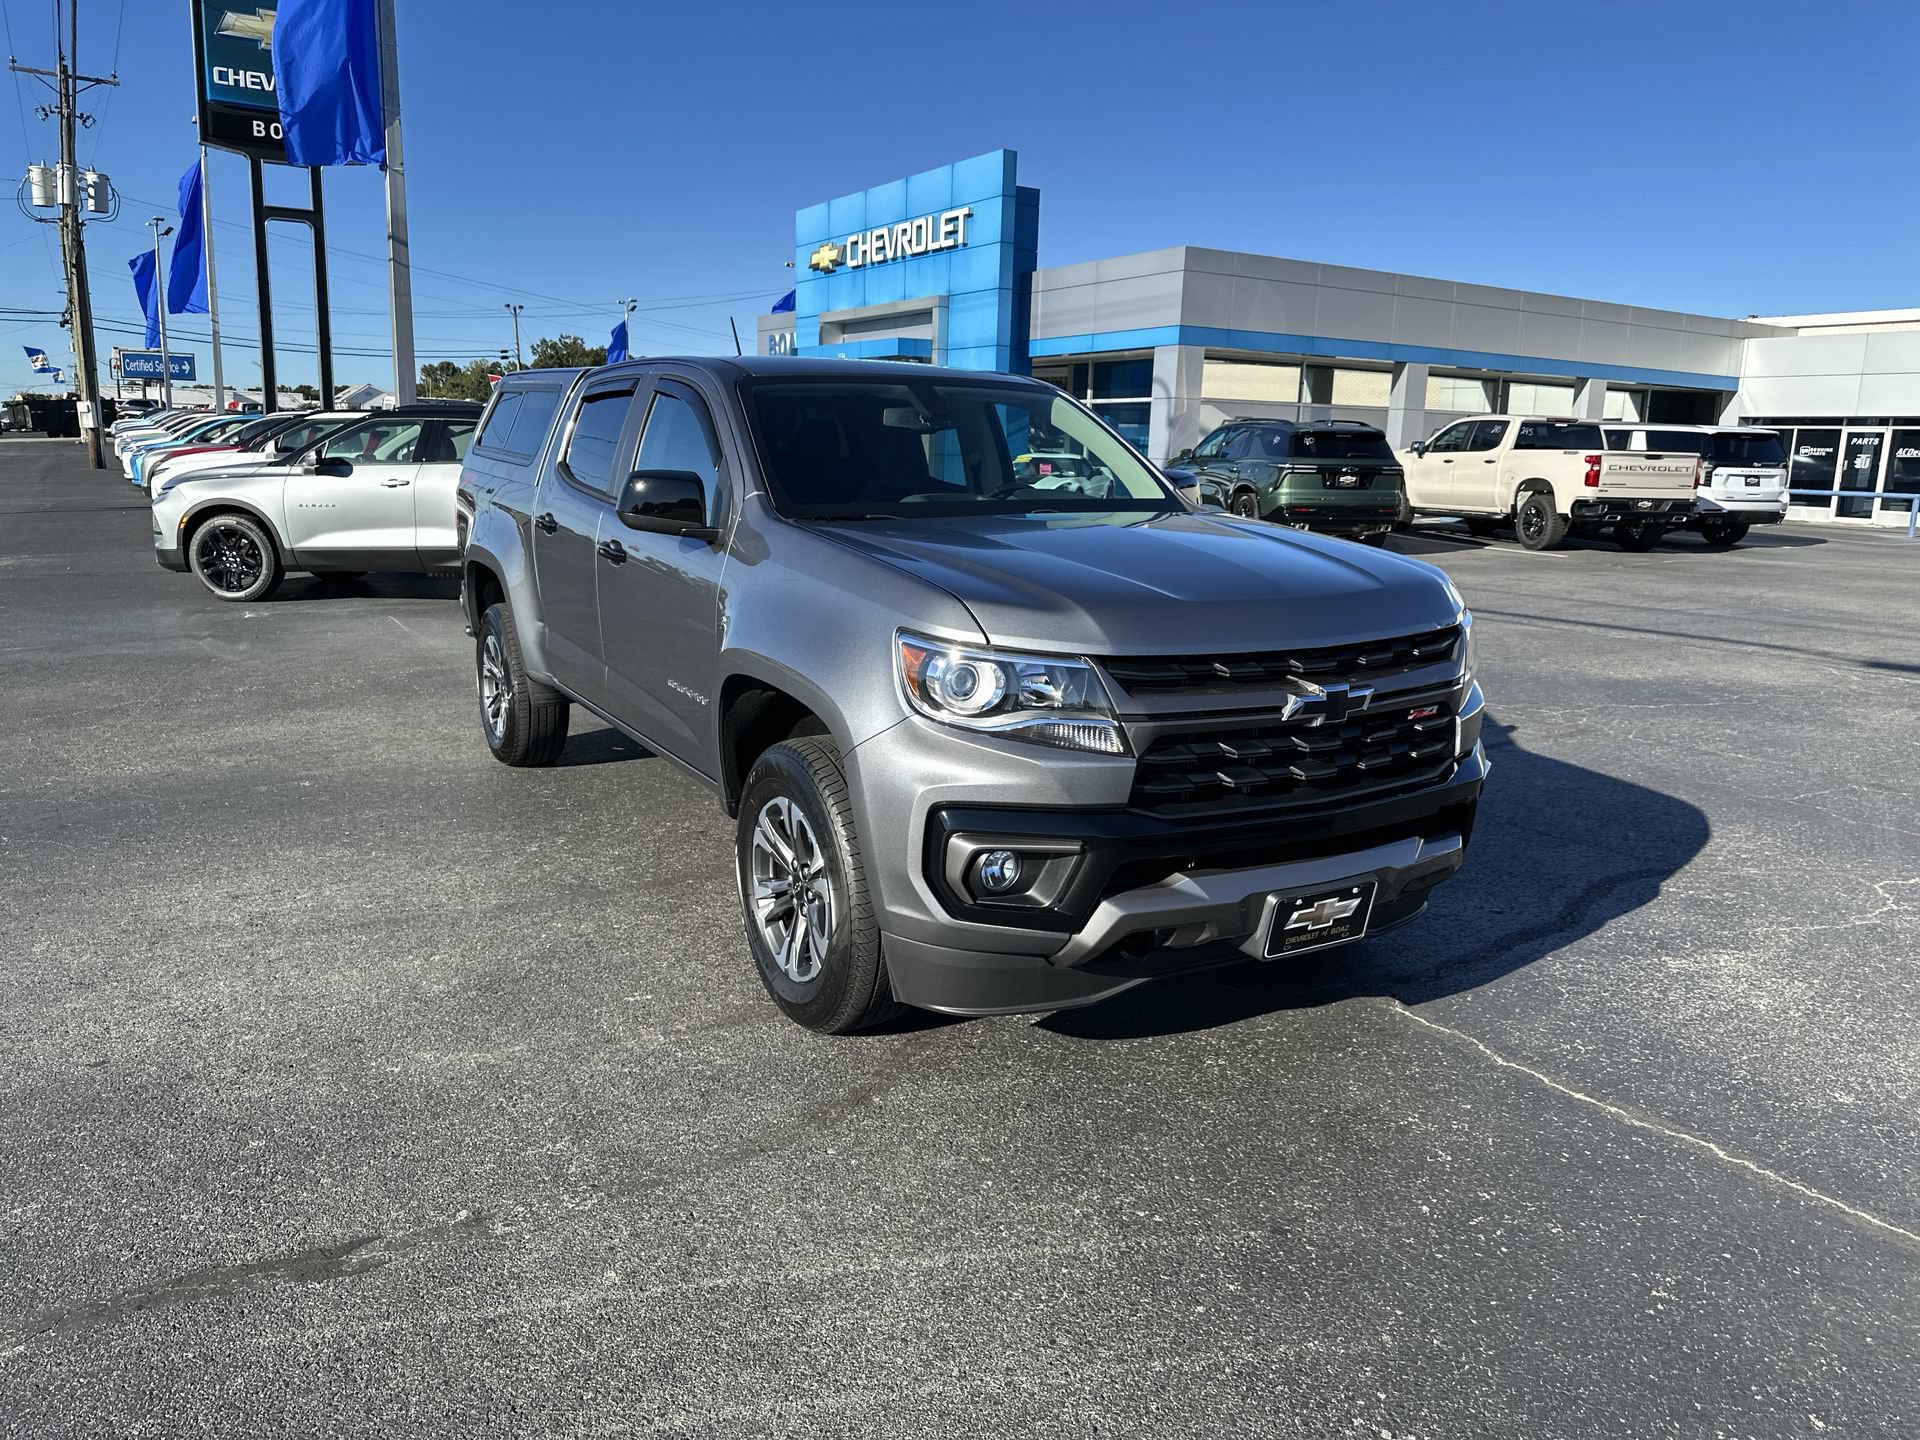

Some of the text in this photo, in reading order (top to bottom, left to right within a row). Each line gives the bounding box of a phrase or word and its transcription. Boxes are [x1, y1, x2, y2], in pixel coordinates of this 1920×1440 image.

[213, 66, 275, 92] CHEV
[252, 120, 283, 140] BO
[846, 207, 971, 268] CHEVROLET
[124, 358, 179, 373] Certified Seice
[1850, 437, 1880, 445] PARTS
[1608, 464, 1692, 473] CHEVROLET
